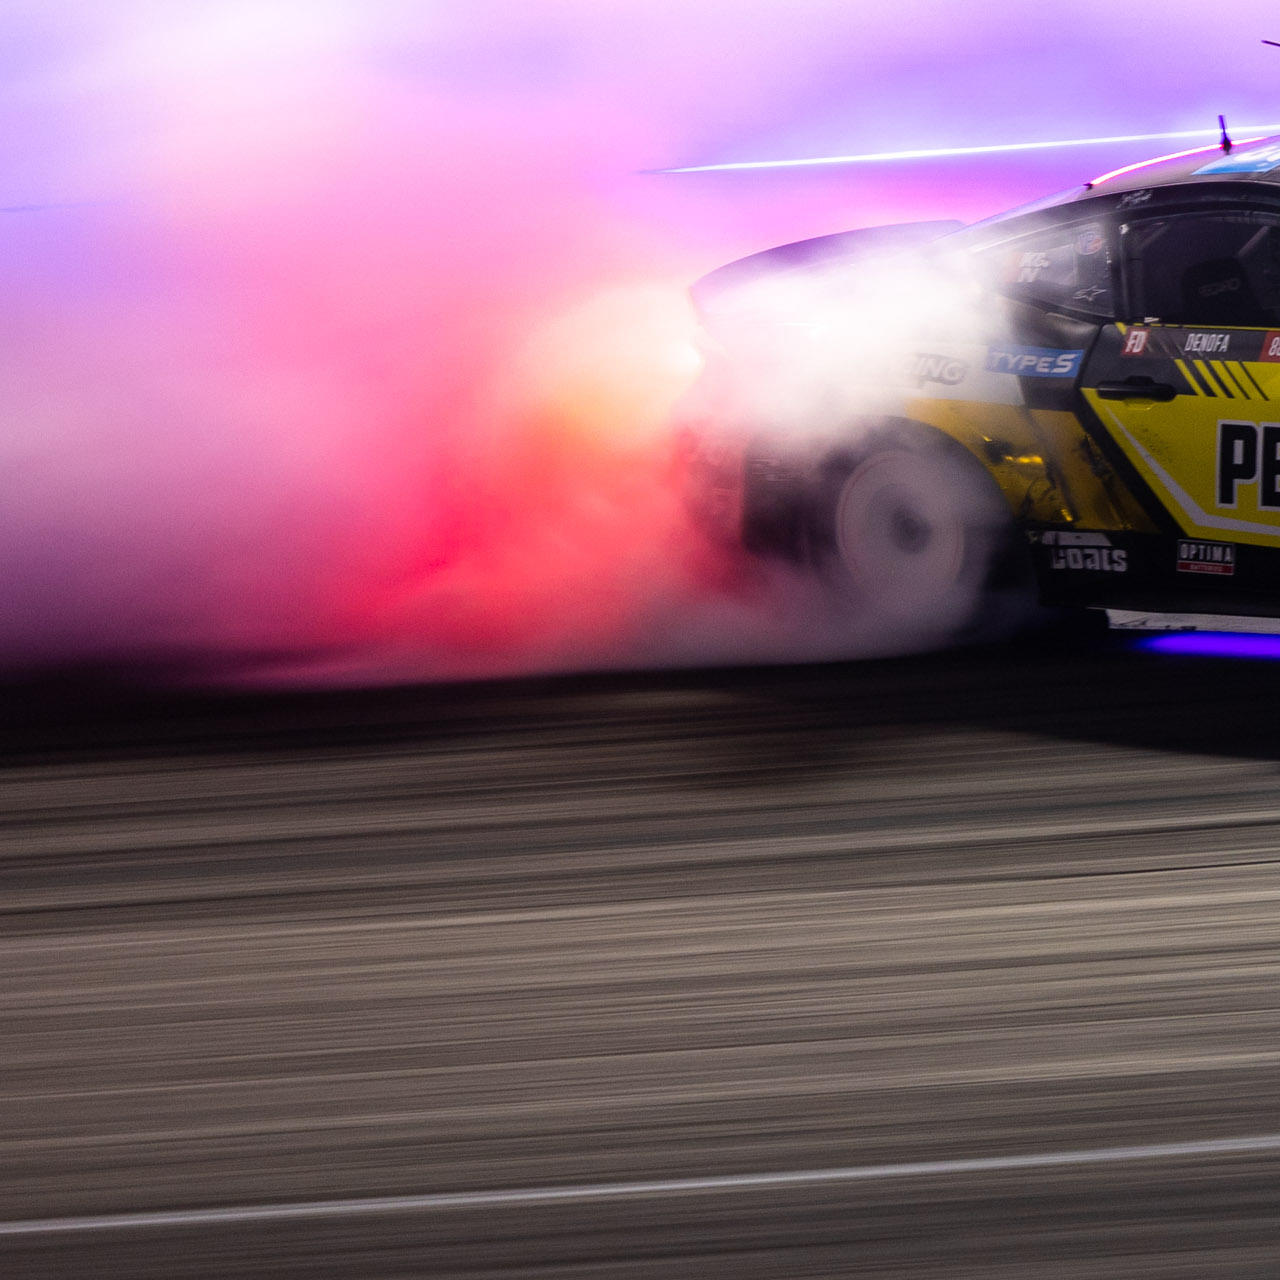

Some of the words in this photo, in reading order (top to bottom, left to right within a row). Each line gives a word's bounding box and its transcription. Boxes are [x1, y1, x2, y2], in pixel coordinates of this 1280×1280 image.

[1125, 331, 1147, 353] FD
[1184, 333, 1230, 353] DENOFA
[1179, 542, 1233, 564] OPTIMA
